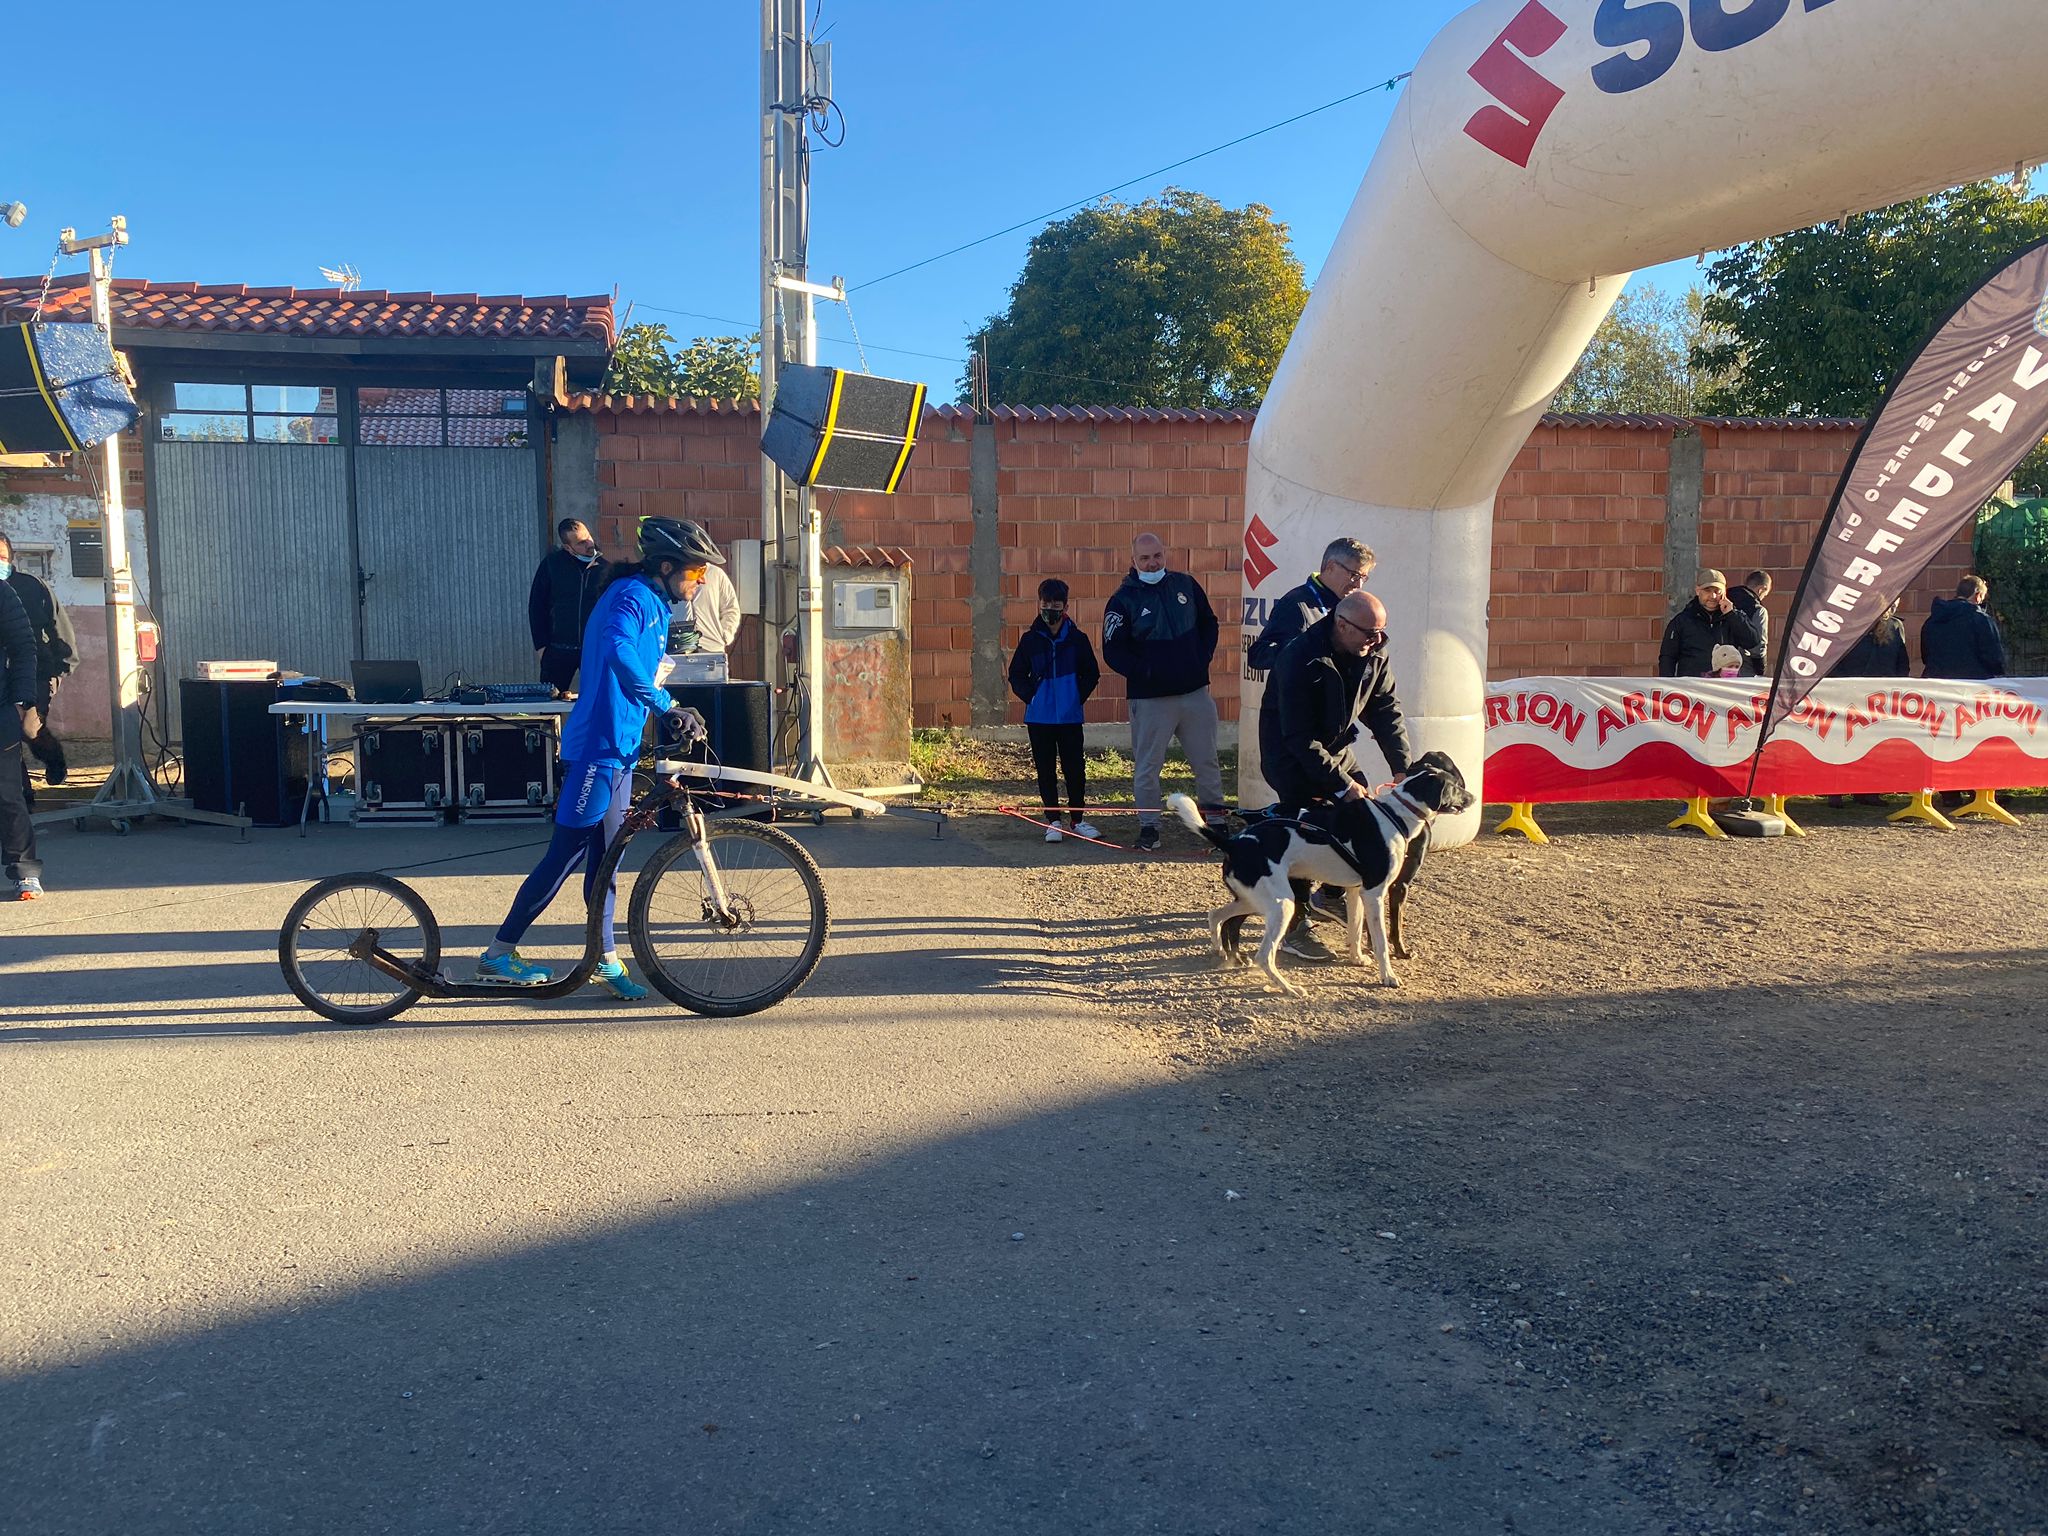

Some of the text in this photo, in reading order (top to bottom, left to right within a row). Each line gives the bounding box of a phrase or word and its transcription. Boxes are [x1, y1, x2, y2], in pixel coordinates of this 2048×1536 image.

[1789, 344, 2048, 677] VALDEFRESNO
[1838, 334, 2011, 543] AYUNTAMIENTO DE
[1485, 687, 2044, 750] RION ARION ARON ARION ARION
